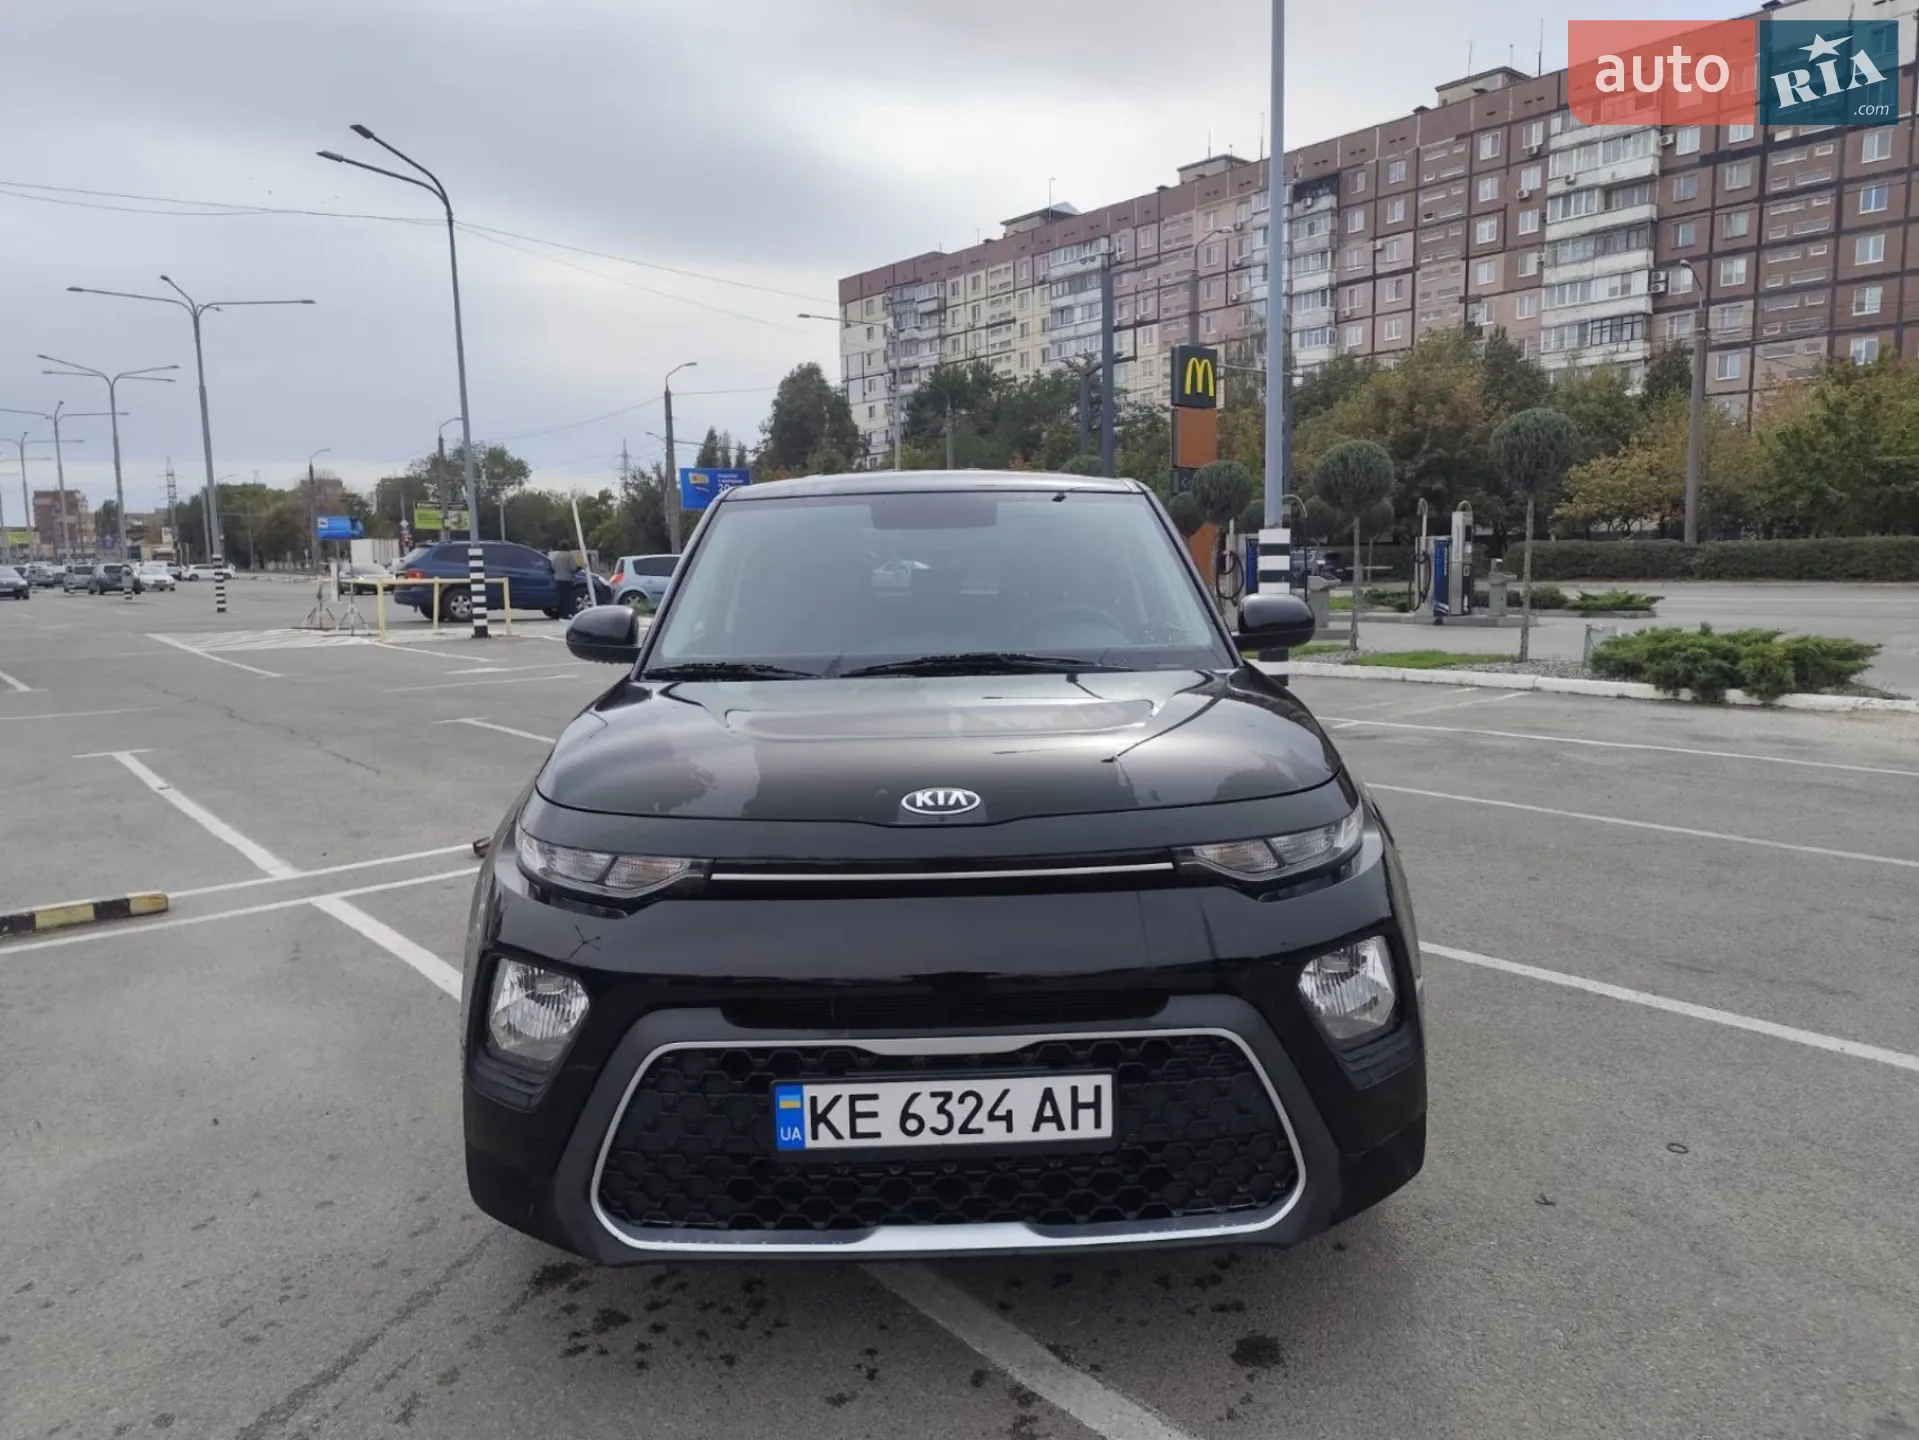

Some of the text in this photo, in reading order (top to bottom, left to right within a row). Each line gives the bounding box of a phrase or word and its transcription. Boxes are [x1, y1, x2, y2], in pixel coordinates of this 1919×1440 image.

[915, 790, 968, 807] KIA
[809, 1084, 1103, 1140] KE 6324 AH
[780, 1126, 802, 1141] UA
